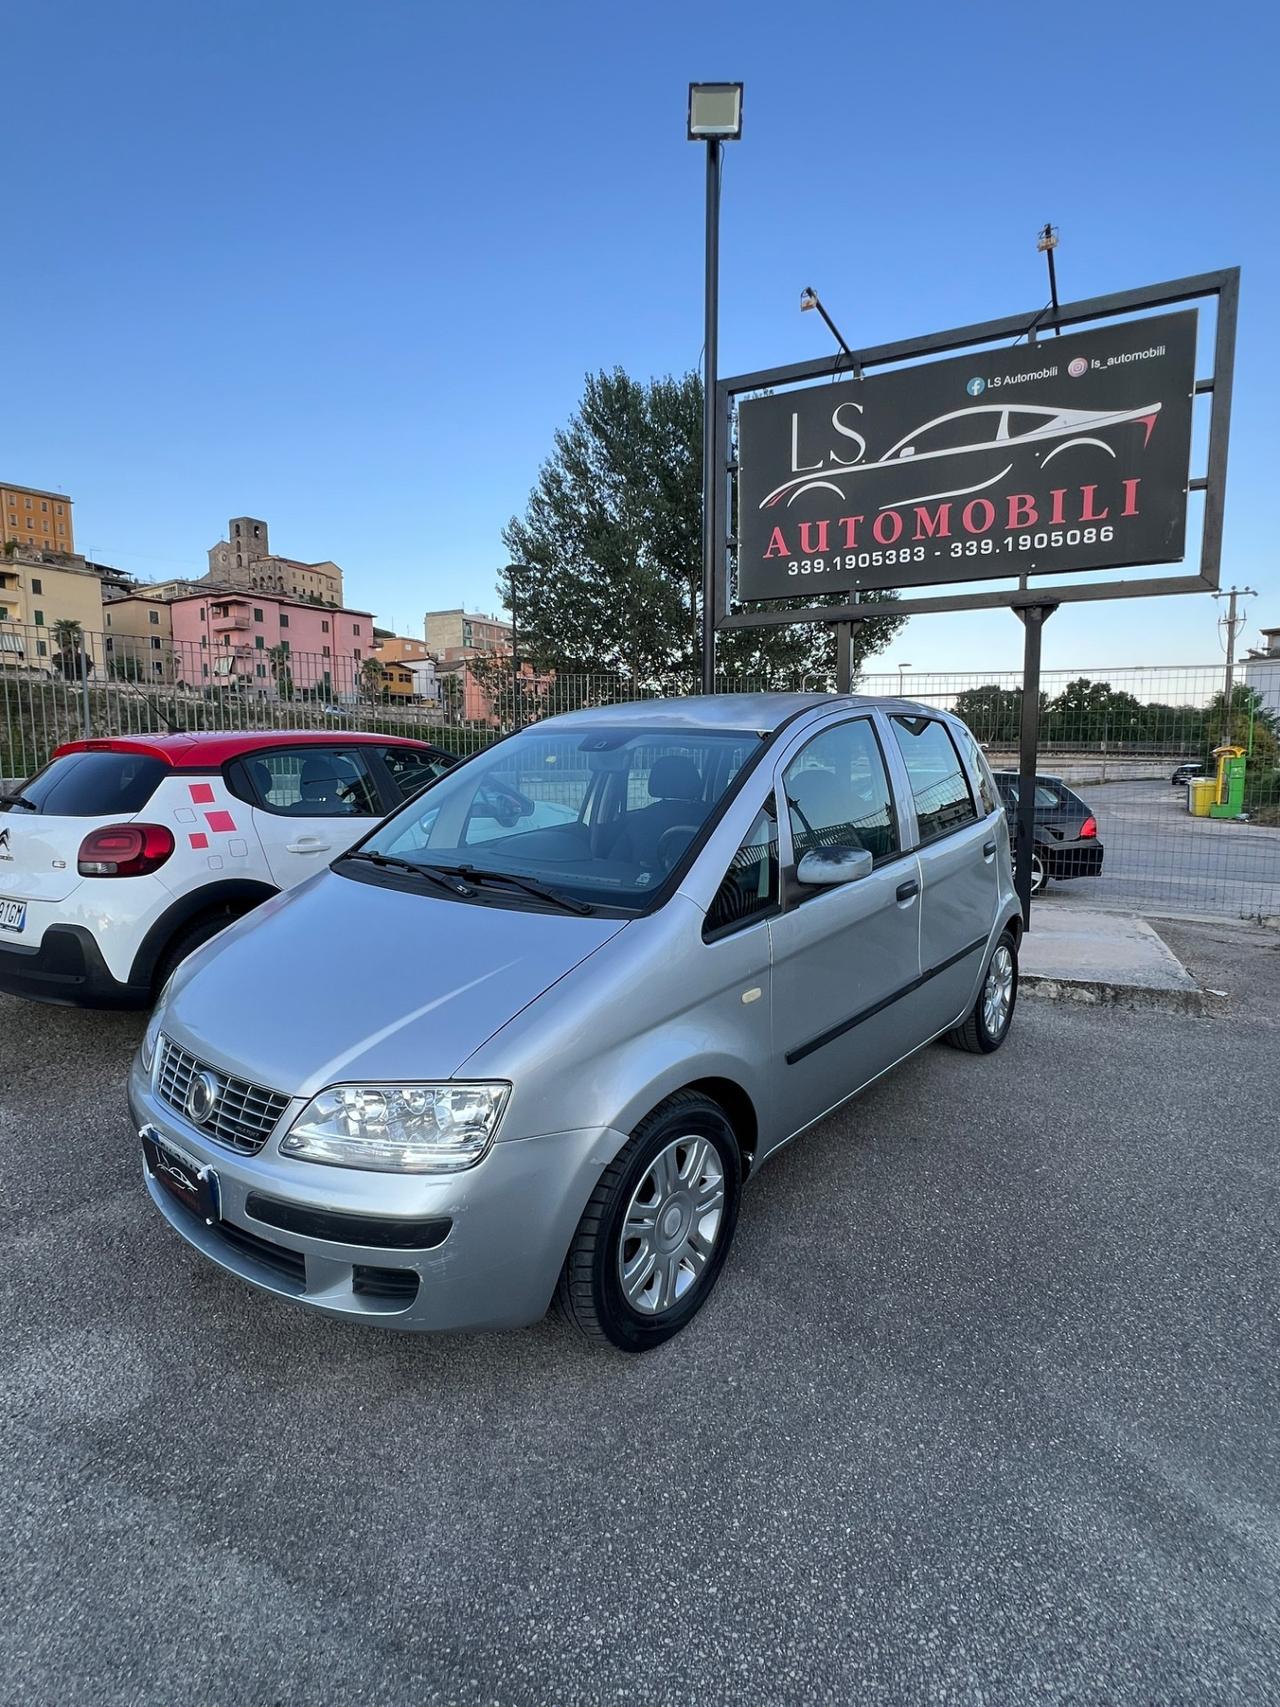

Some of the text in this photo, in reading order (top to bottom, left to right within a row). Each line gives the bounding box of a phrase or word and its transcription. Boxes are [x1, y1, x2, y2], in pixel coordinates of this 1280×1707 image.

[1091, 345, 1166, 369] ls_automobili
[987, 378, 1002, 388] LS
[1003, 367, 1058, 386] Automobili
[762, 479, 1142, 558] AUTOMOBILI
[787, 547, 925, 576] 339.1905383
[950, 526, 1114, 558] 339.1905086
